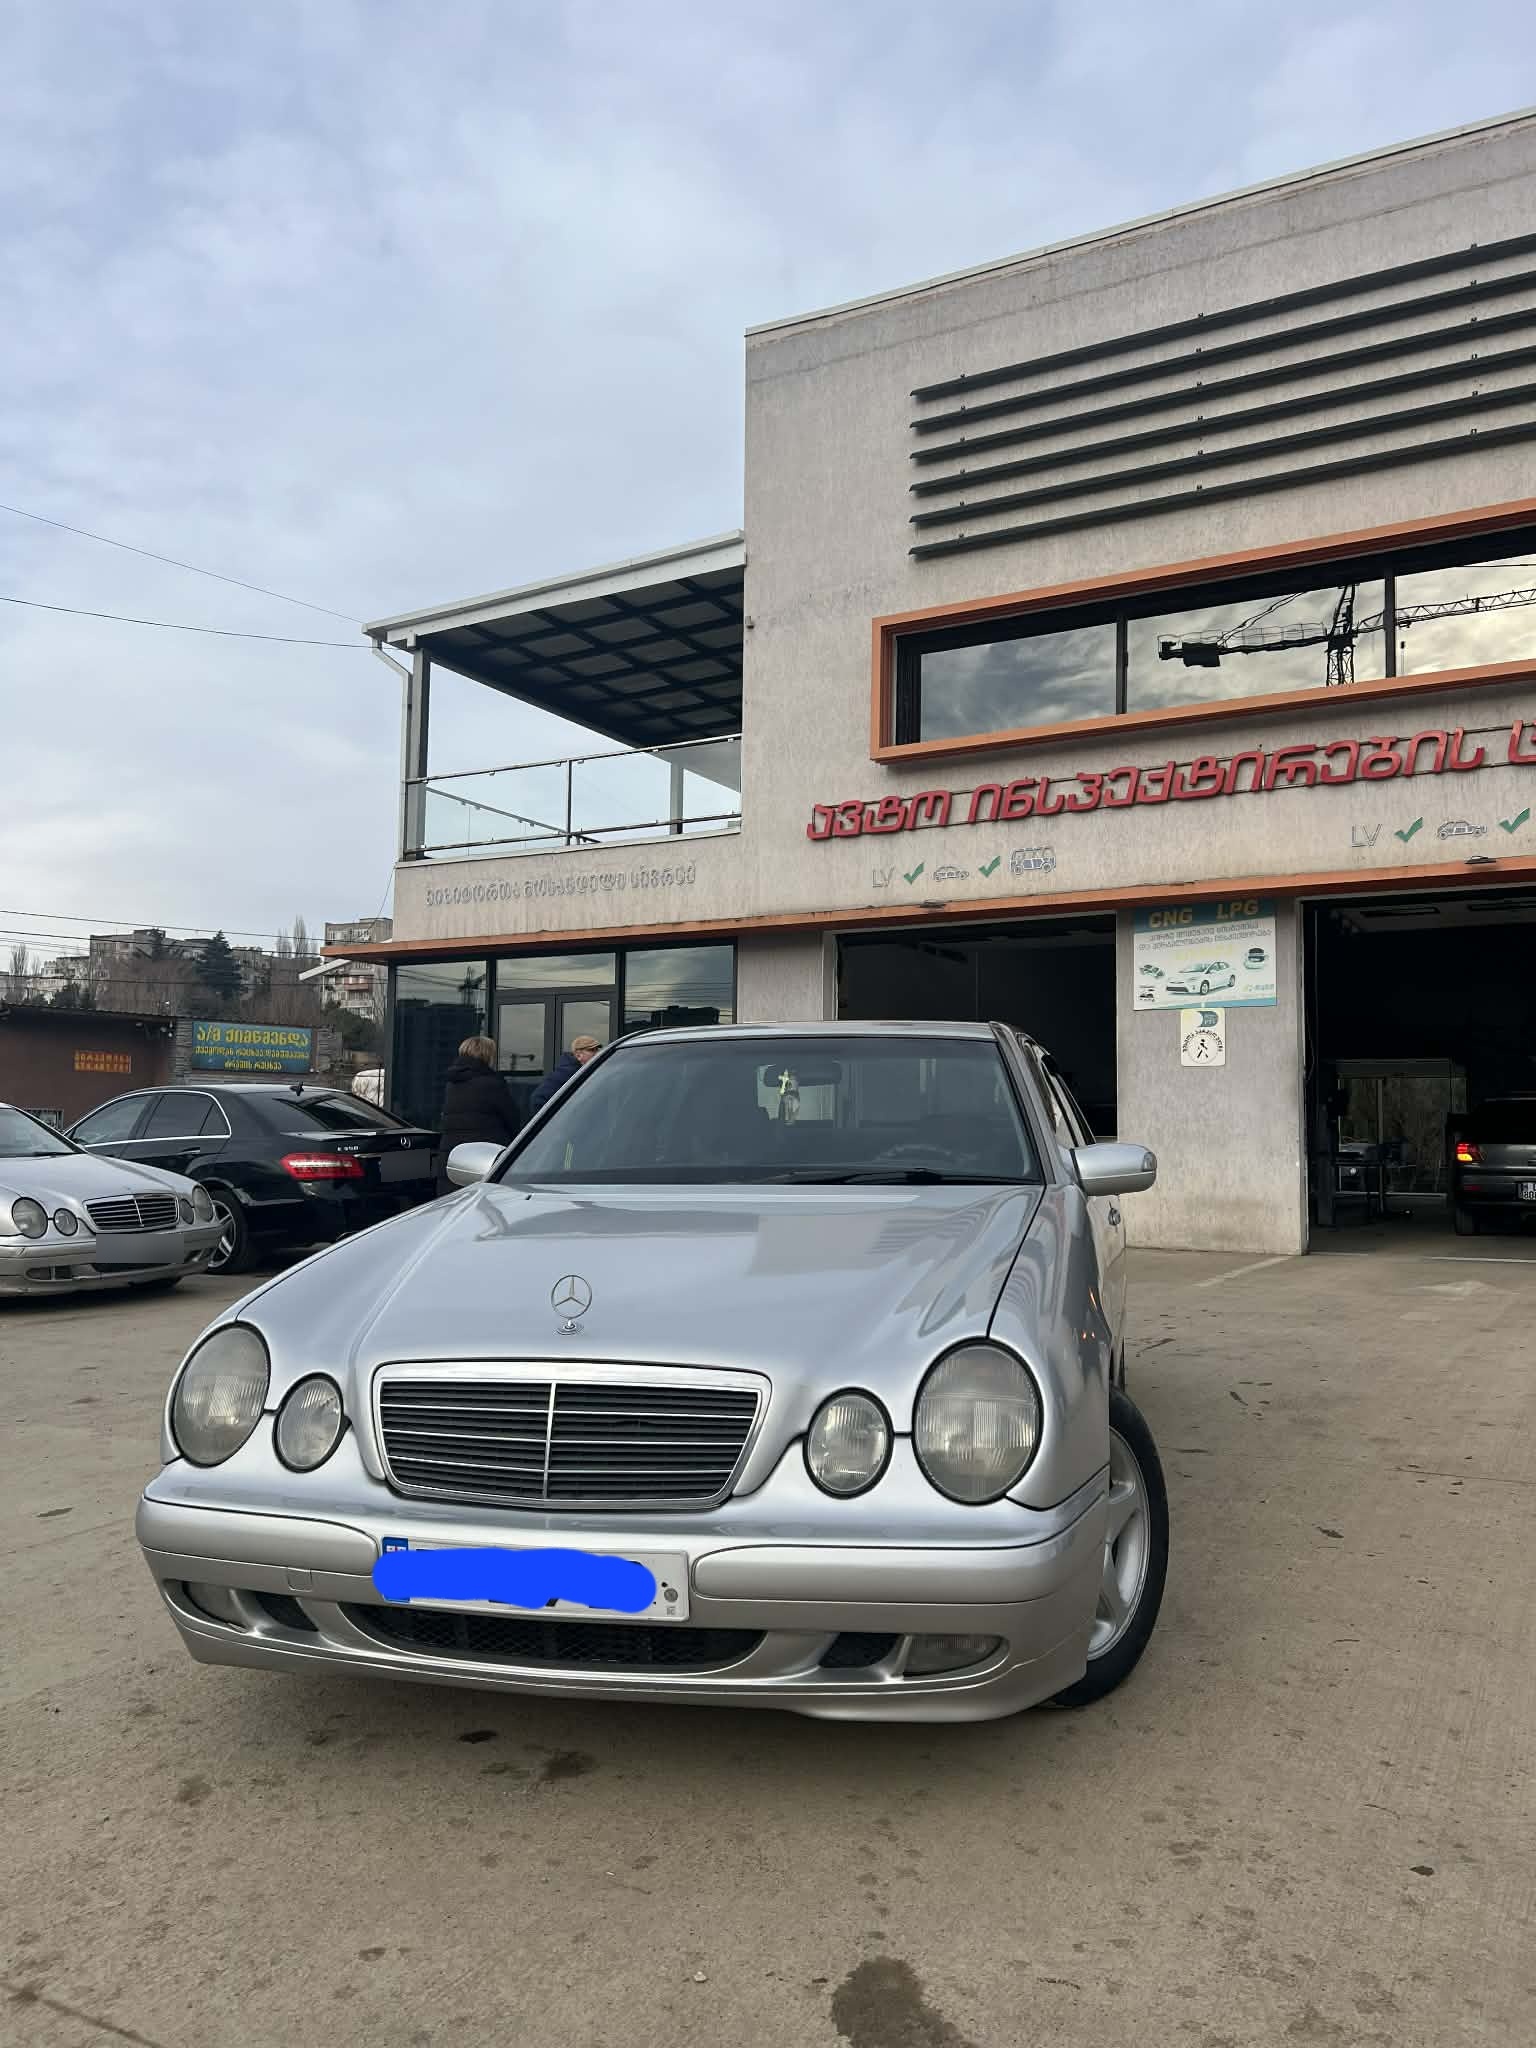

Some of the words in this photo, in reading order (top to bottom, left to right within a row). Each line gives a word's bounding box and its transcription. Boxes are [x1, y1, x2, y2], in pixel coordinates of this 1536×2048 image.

[806, 790, 953, 841] ავტო
[968, 727, 1485, 824] ინსპექტირების
[1148, 908, 1193, 928] CNG
[1217, 900, 1258, 920] LPG
